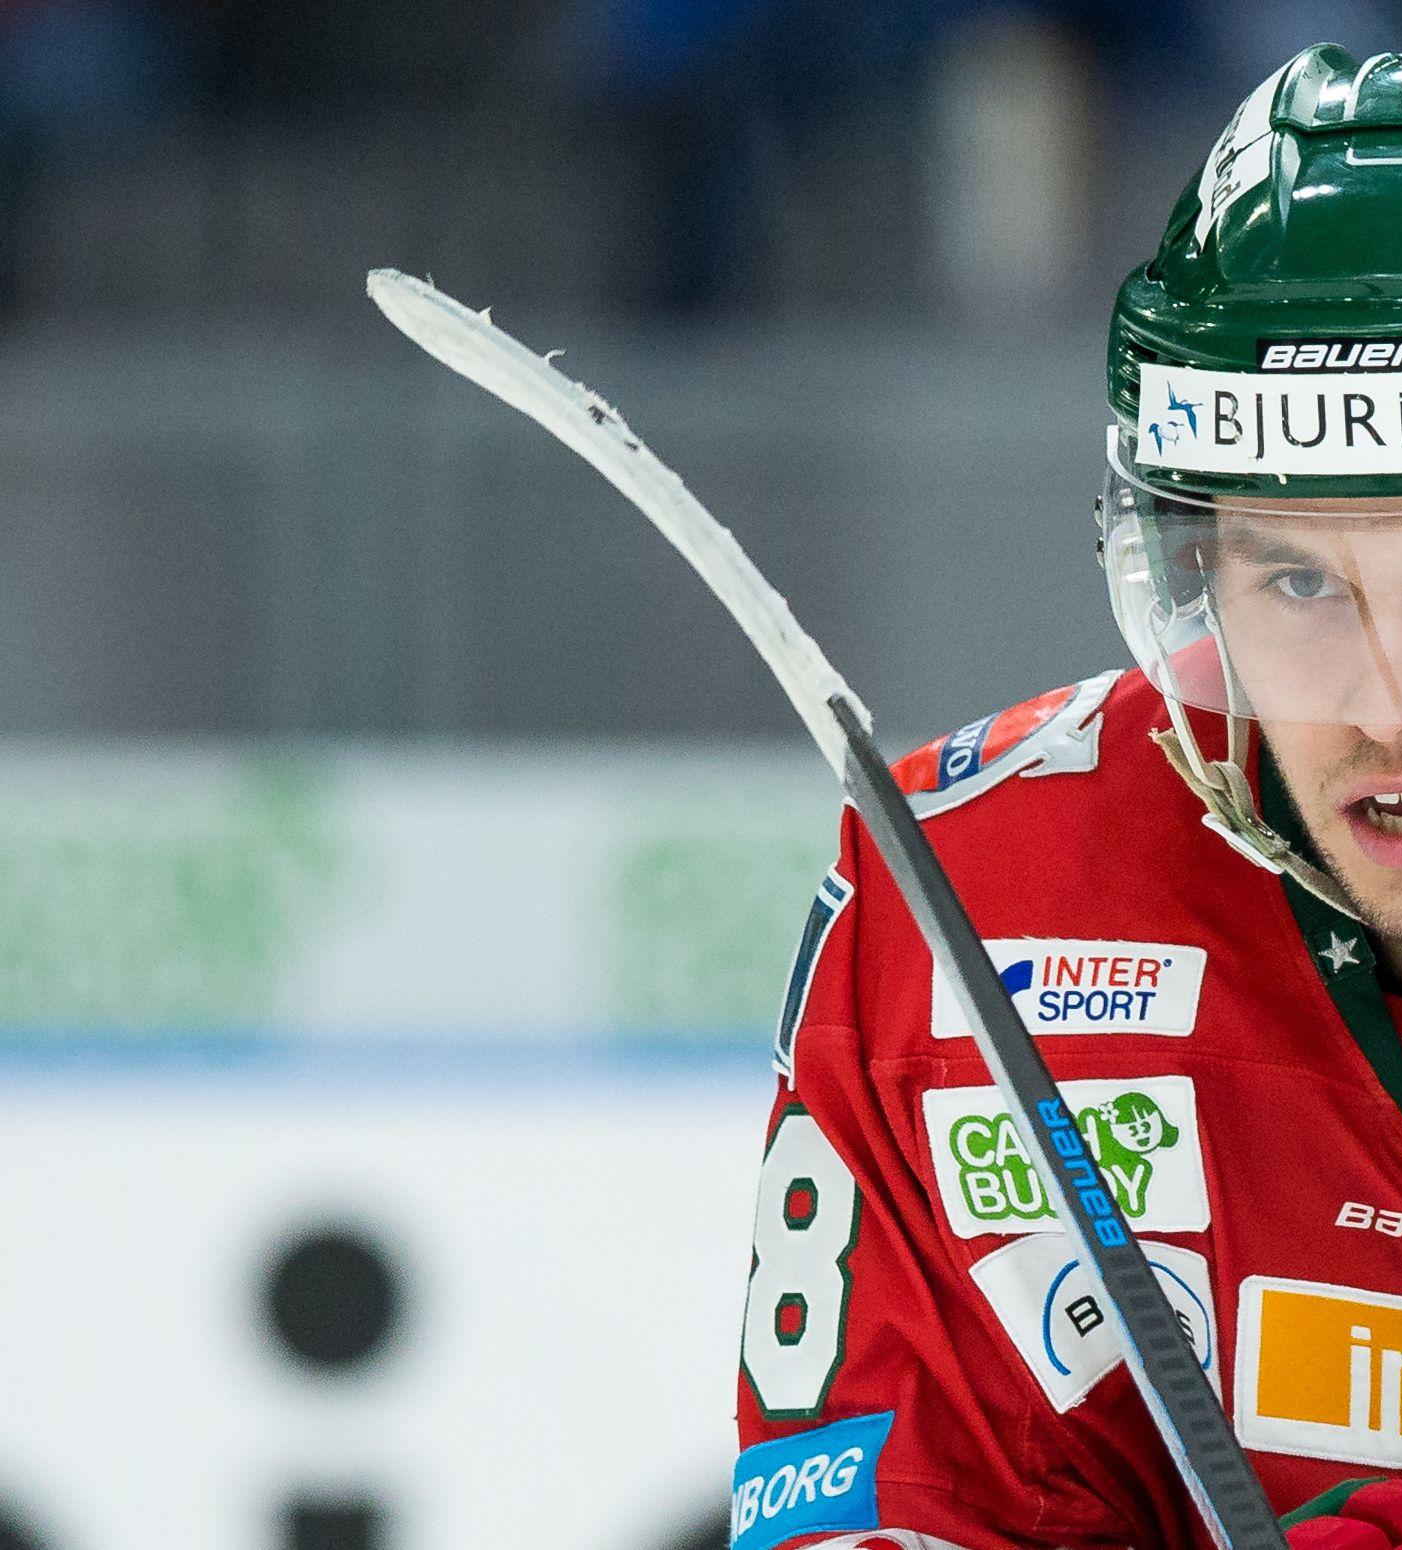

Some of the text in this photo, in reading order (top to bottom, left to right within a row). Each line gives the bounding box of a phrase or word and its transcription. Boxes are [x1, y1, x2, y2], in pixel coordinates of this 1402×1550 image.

[1043, 956, 1161, 987] INTER
[1038, 990, 1156, 1021] SPORT
[957, 1115, 1101, 1168] CAH
[965, 1164, 1145, 1213] BUY
[741, 1102, 864, 1420] 8
